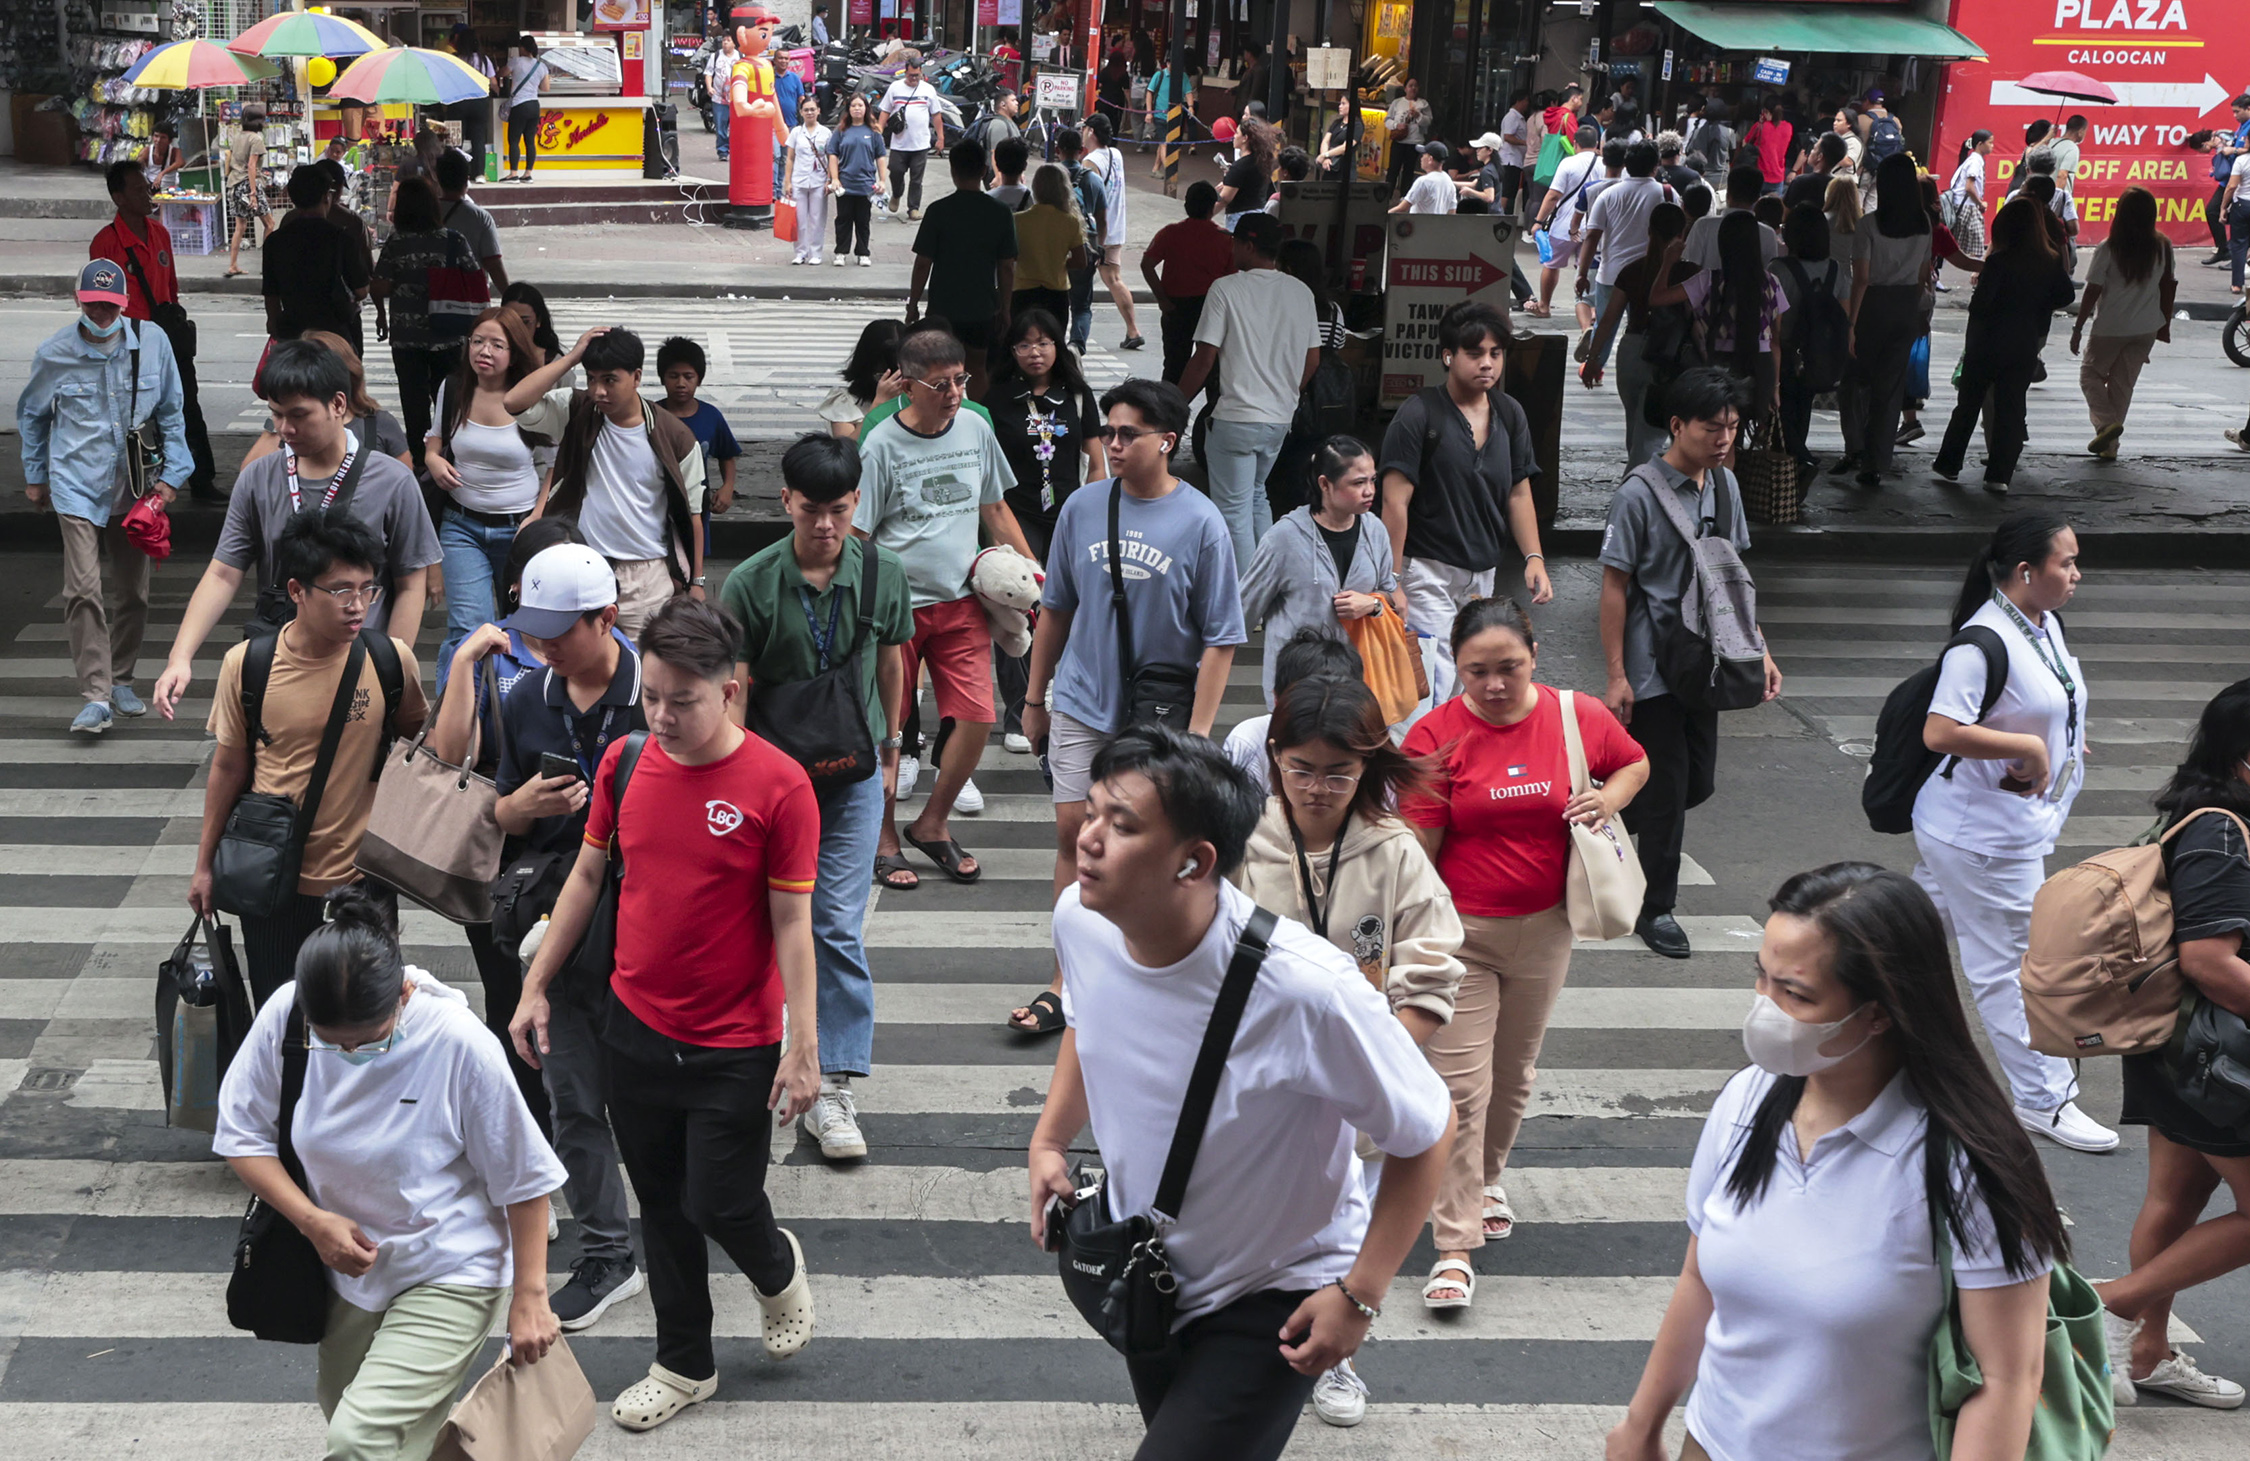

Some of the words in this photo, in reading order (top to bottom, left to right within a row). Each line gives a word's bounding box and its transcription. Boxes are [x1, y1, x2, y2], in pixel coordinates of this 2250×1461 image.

[2054, 0, 2188, 30] PLAZA
[2068, 49, 2166, 65] CALOOCAN
[2093, 124, 2148, 146] WAY
[2154, 124, 2188, 146] TO
[2125, 160, 2188, 180] AREA
[1401, 264, 1438, 281] THIS
[1445, 265, 1482, 282] SIDE
[1408, 303, 1444, 320] TAW
[1396, 323, 1439, 340] PAPU
[335, 467, 348, 482] THE
[2003, 603, 2027, 630] COLLEGE
[1490, 780, 1552, 800] tommy
[707, 807, 737, 827] LBC
